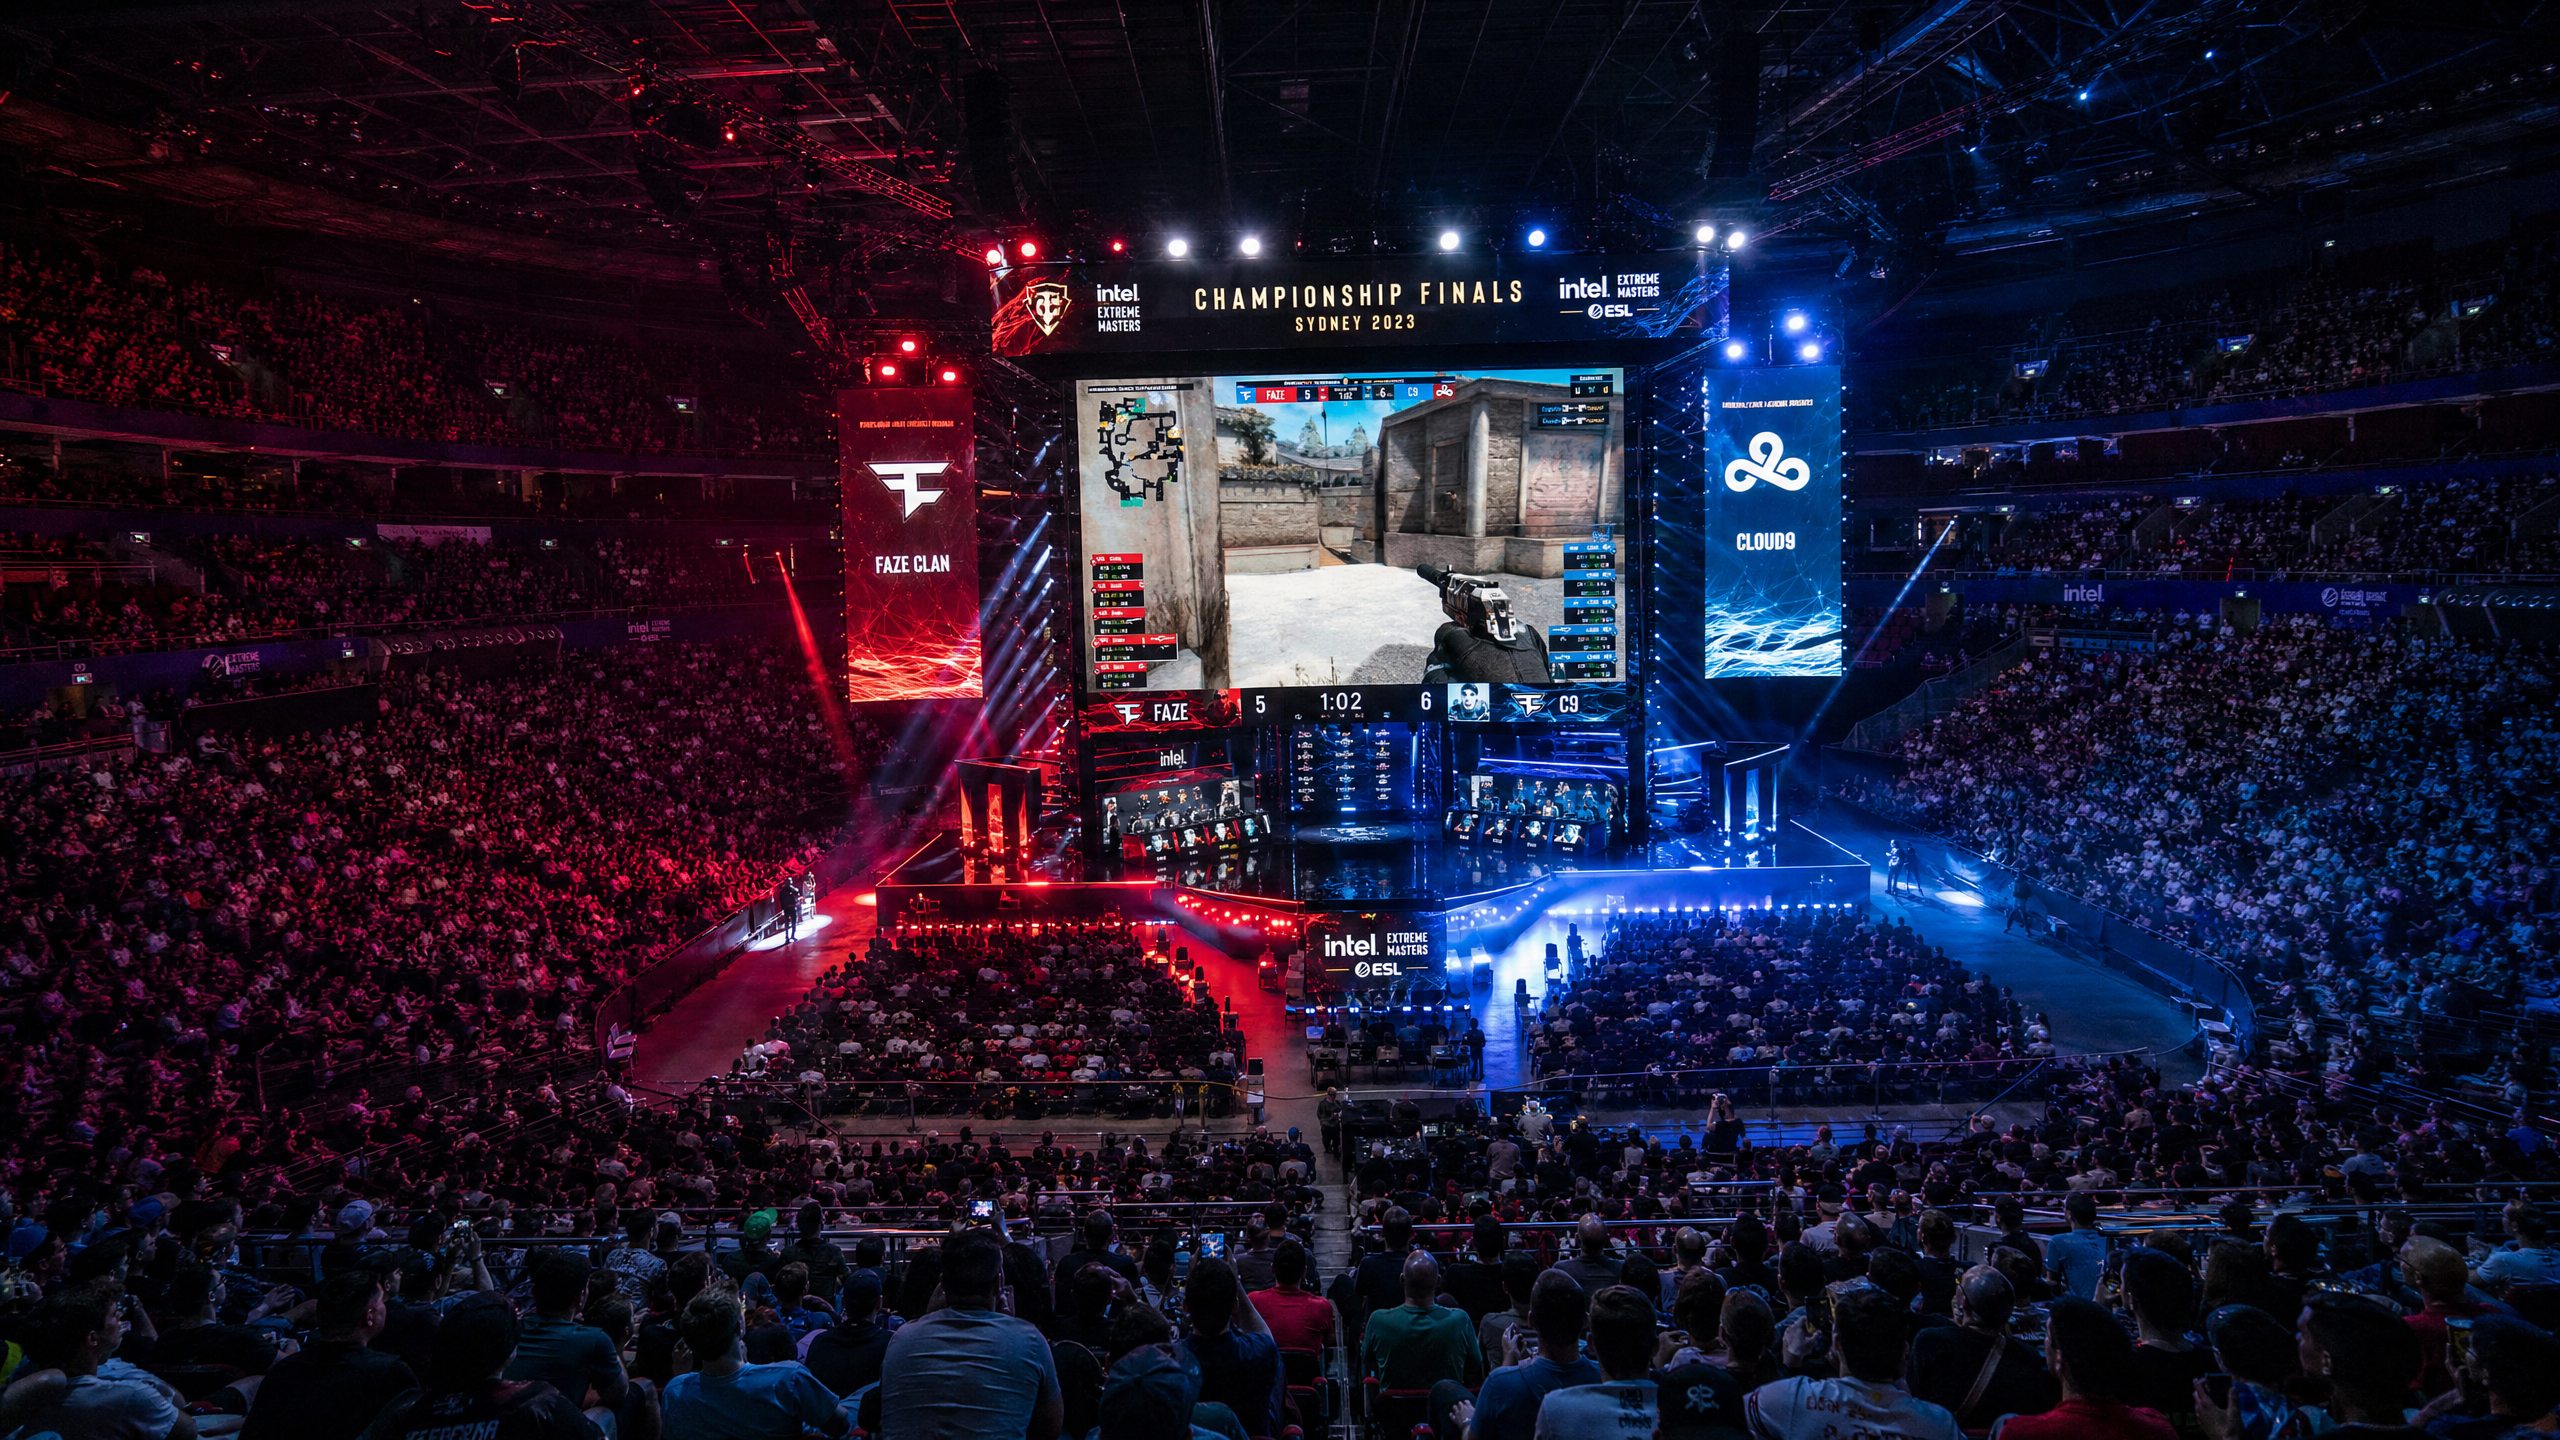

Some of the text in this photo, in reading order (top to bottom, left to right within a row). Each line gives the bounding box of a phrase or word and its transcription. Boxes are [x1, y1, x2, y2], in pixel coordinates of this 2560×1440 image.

[1617, 272, 1660, 286] EXTREME
[1193, 279, 1524, 311] CHAMPIONSHIP FINALS
[1617, 285, 1660, 299] MASTERS
[1097, 305, 1141, 319] EXTREME
[1604, 304, 1634, 318] ESL
[1098, 319, 1141, 333] MASTERS
[1294, 313, 1416, 333] SYDNEY 2023
[1379, 387, 1386, 398] 6
[1407, 386, 1419, 397] C9
[1736, 531, 1796, 551] CLOUD9
[875, 554, 951, 575] FAZE CLAN
[1255, 694, 1266, 714] 5
[1319, 691, 1362, 711] 1:02
[1420, 690, 1432, 711] 6
[1558, 694, 1580, 714] C9
[1153, 702, 1189, 723] FAZE
[1386, 931, 1429, 944] EXTREME
[1386, 944, 1429, 957] MASTERS
[1371, 962, 1402, 976] ESL
